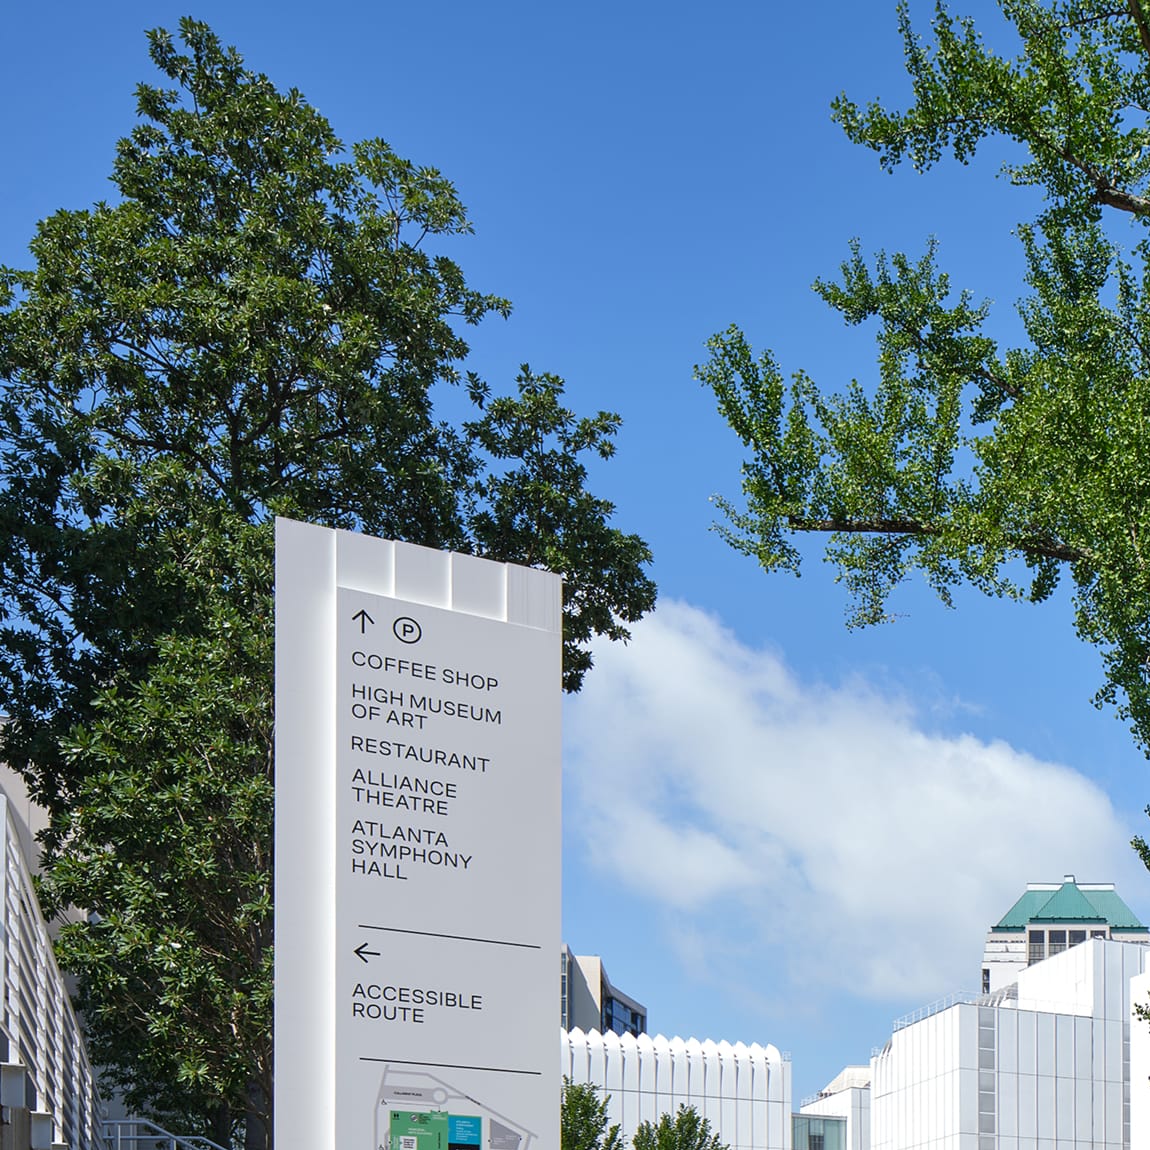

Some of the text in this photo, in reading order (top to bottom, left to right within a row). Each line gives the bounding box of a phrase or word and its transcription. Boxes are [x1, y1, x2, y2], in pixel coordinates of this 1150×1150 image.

[351, 650, 499, 692] COFFEE SHOP
[351, 682, 502, 725] HIGH MUSEUM
[351, 703, 429, 730] OF ART
[351, 734, 491, 773] RESTAURANT
[351, 767, 457, 799] ALLIANCE
[351, 785, 449, 817] THEATRE
[351, 819, 449, 848] ATLANTA
[351, 838, 473, 870] SYMPHONY
[351, 857, 409, 881] HALL
[351, 982, 483, 1011] ACCESSIBLE
[351, 1001, 425, 1025] ROUTE
